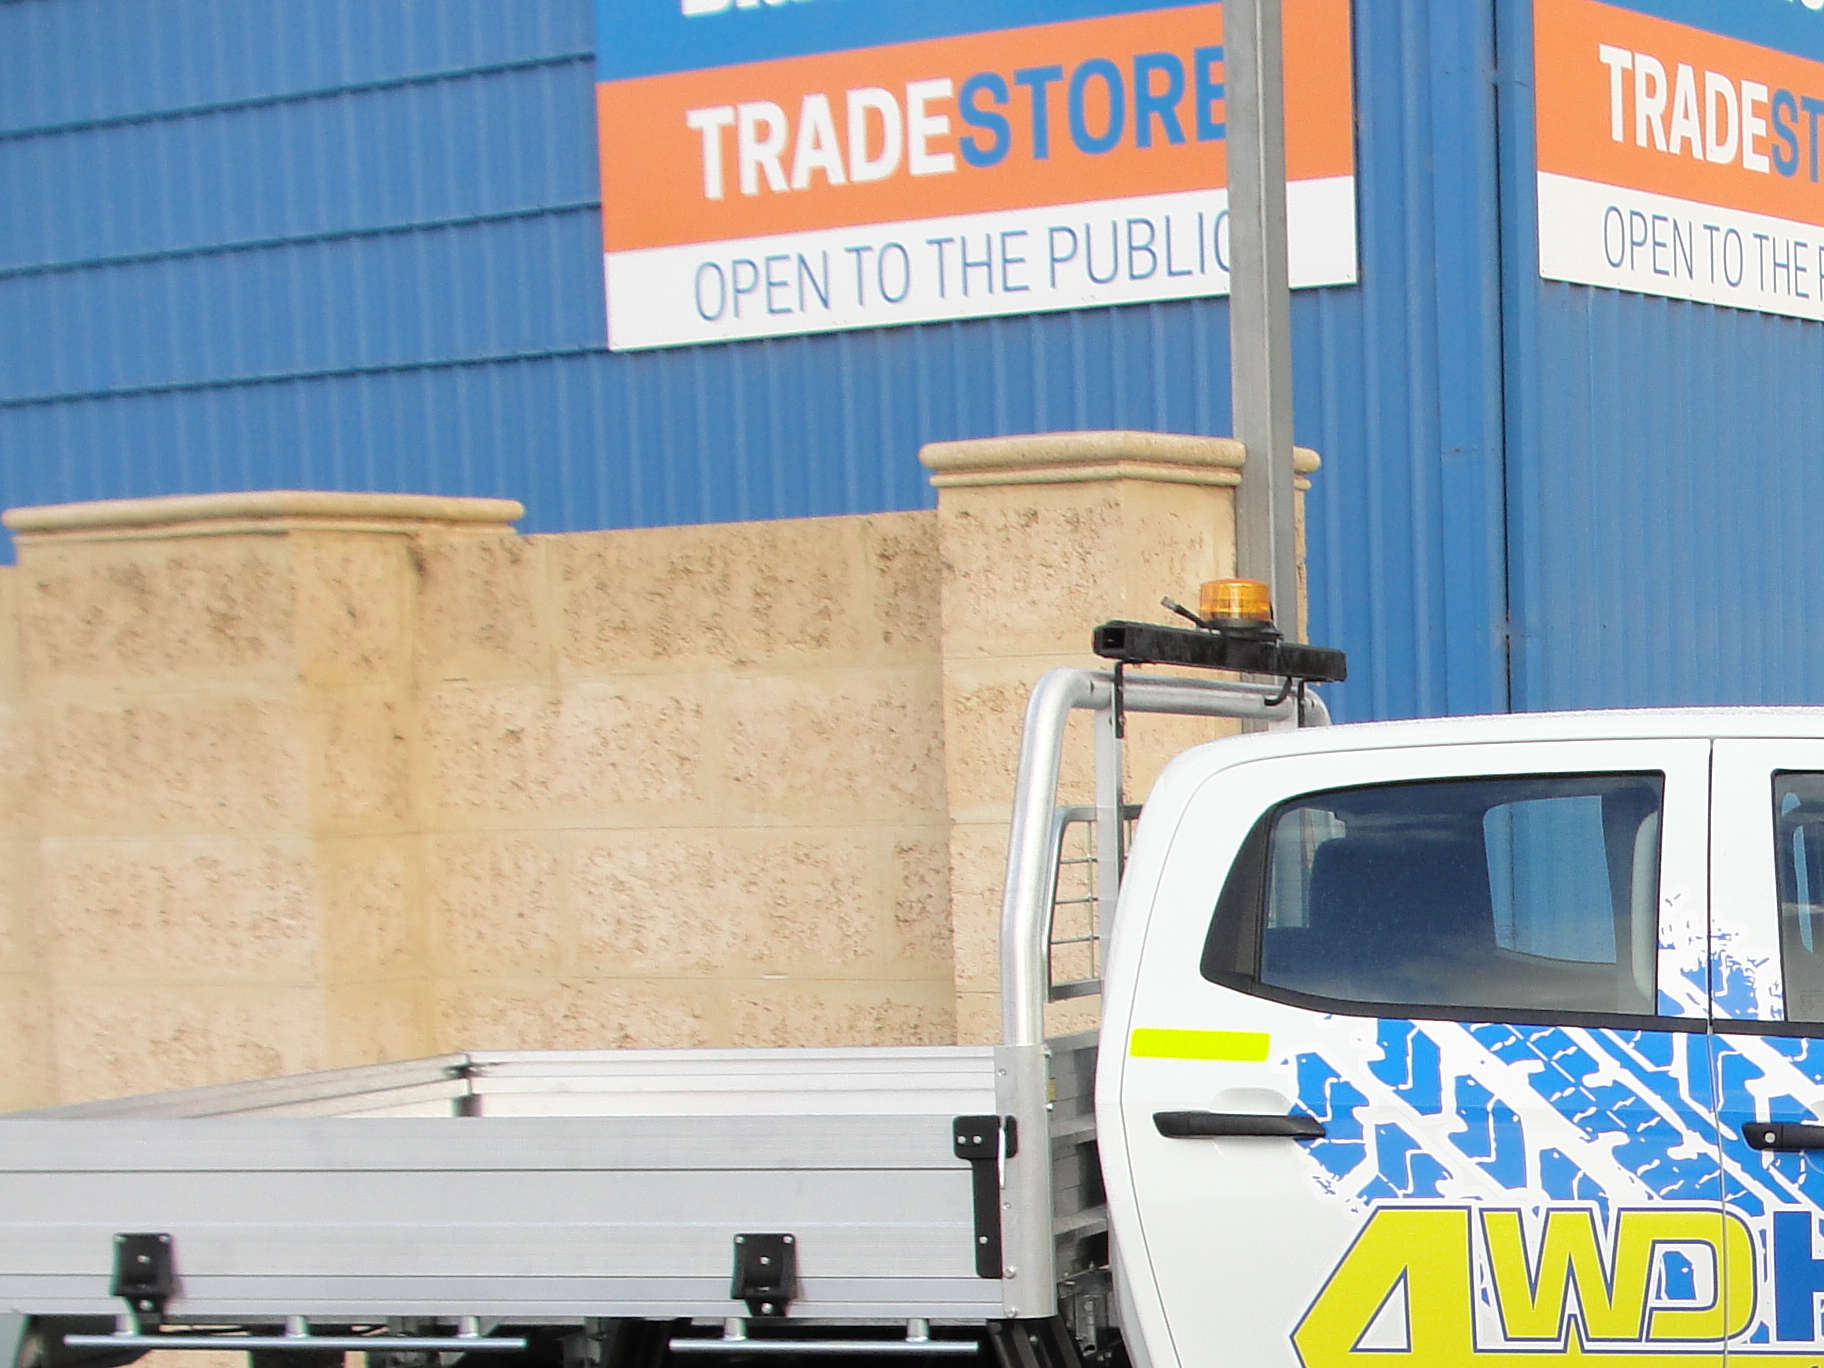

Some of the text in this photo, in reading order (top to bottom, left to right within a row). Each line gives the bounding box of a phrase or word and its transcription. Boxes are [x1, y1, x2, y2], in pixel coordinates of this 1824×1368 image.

[686, 46, 1227, 200] TRADESTORE
[693, 251, 831, 323] OPEN
[845, 241, 912, 307] TO
[926, 230, 1031, 297] THE
[1603, 205, 1695, 282] OPEN
[1702, 223, 1744, 288] TO
[1752, 232, 1811, 300] THE
